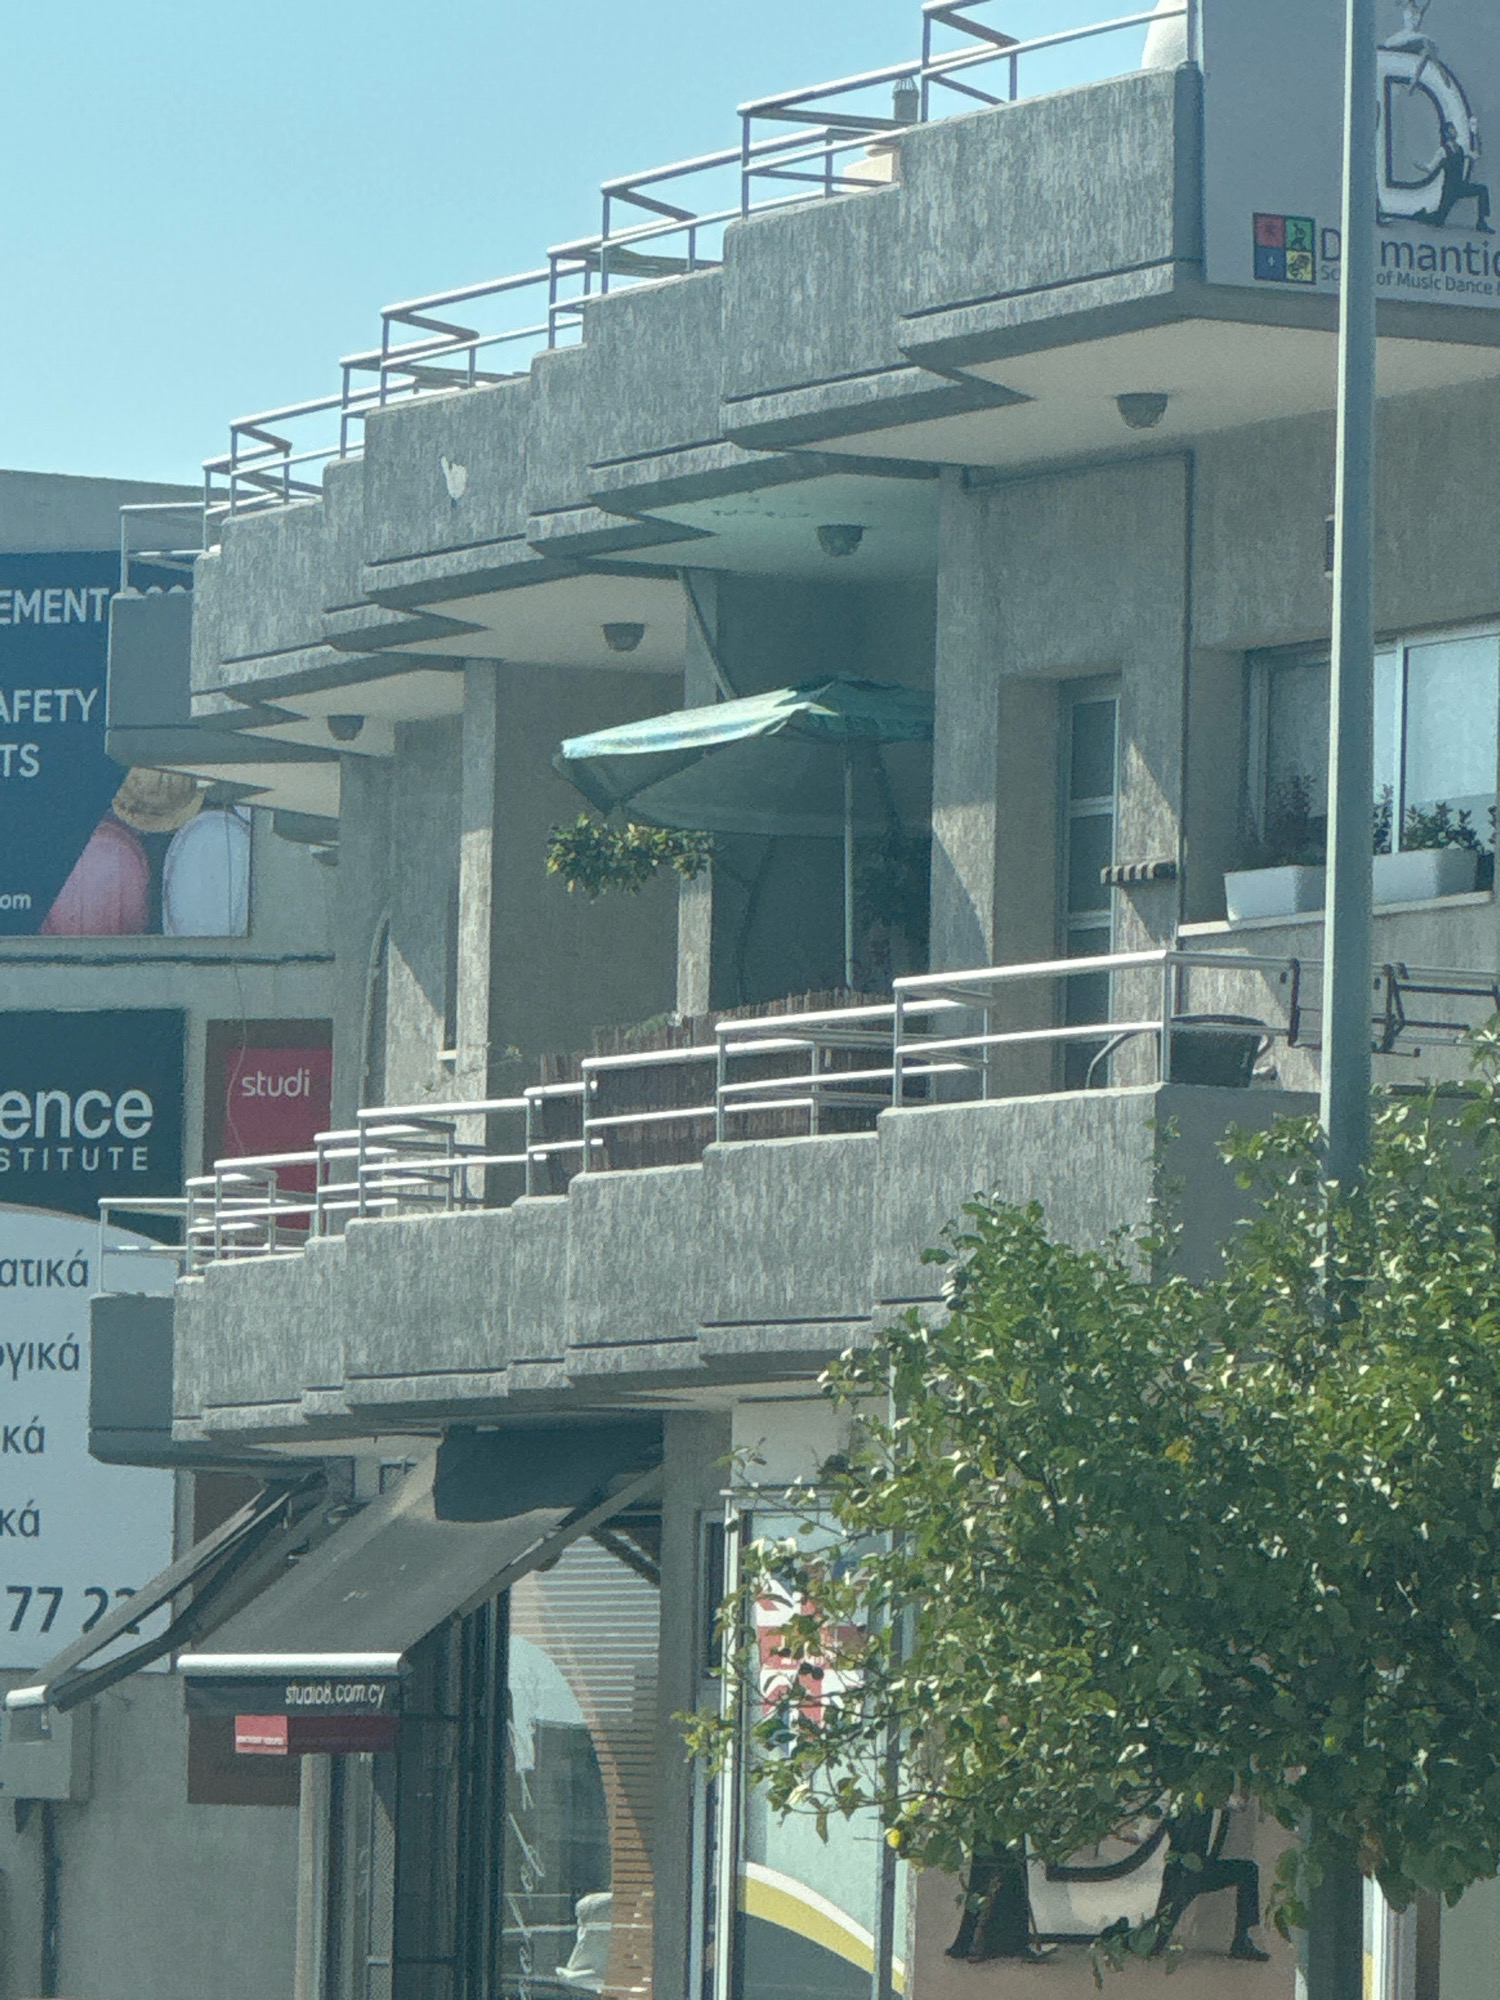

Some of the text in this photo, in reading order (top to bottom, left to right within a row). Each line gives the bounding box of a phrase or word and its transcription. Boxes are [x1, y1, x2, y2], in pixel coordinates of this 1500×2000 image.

[1321, 227, 1500, 277] Dmanti
[1376, 270, 1392, 286] of
[1397, 272, 1442, 291] Music
[1445, 276, 1493, 296] Dance
[0, 588, 110, 624] EMENT
[0, 744, 40, 778] TS
[0, 893, 32, 910] om
[242, 1068, 310, 1098] studi
[0, 1089, 154, 1139] ence
[0, 1146, 149, 1173] STITUTE
[0, 1332, 80, 1381] γικά
[6, 1585, 63, 1633] 77
